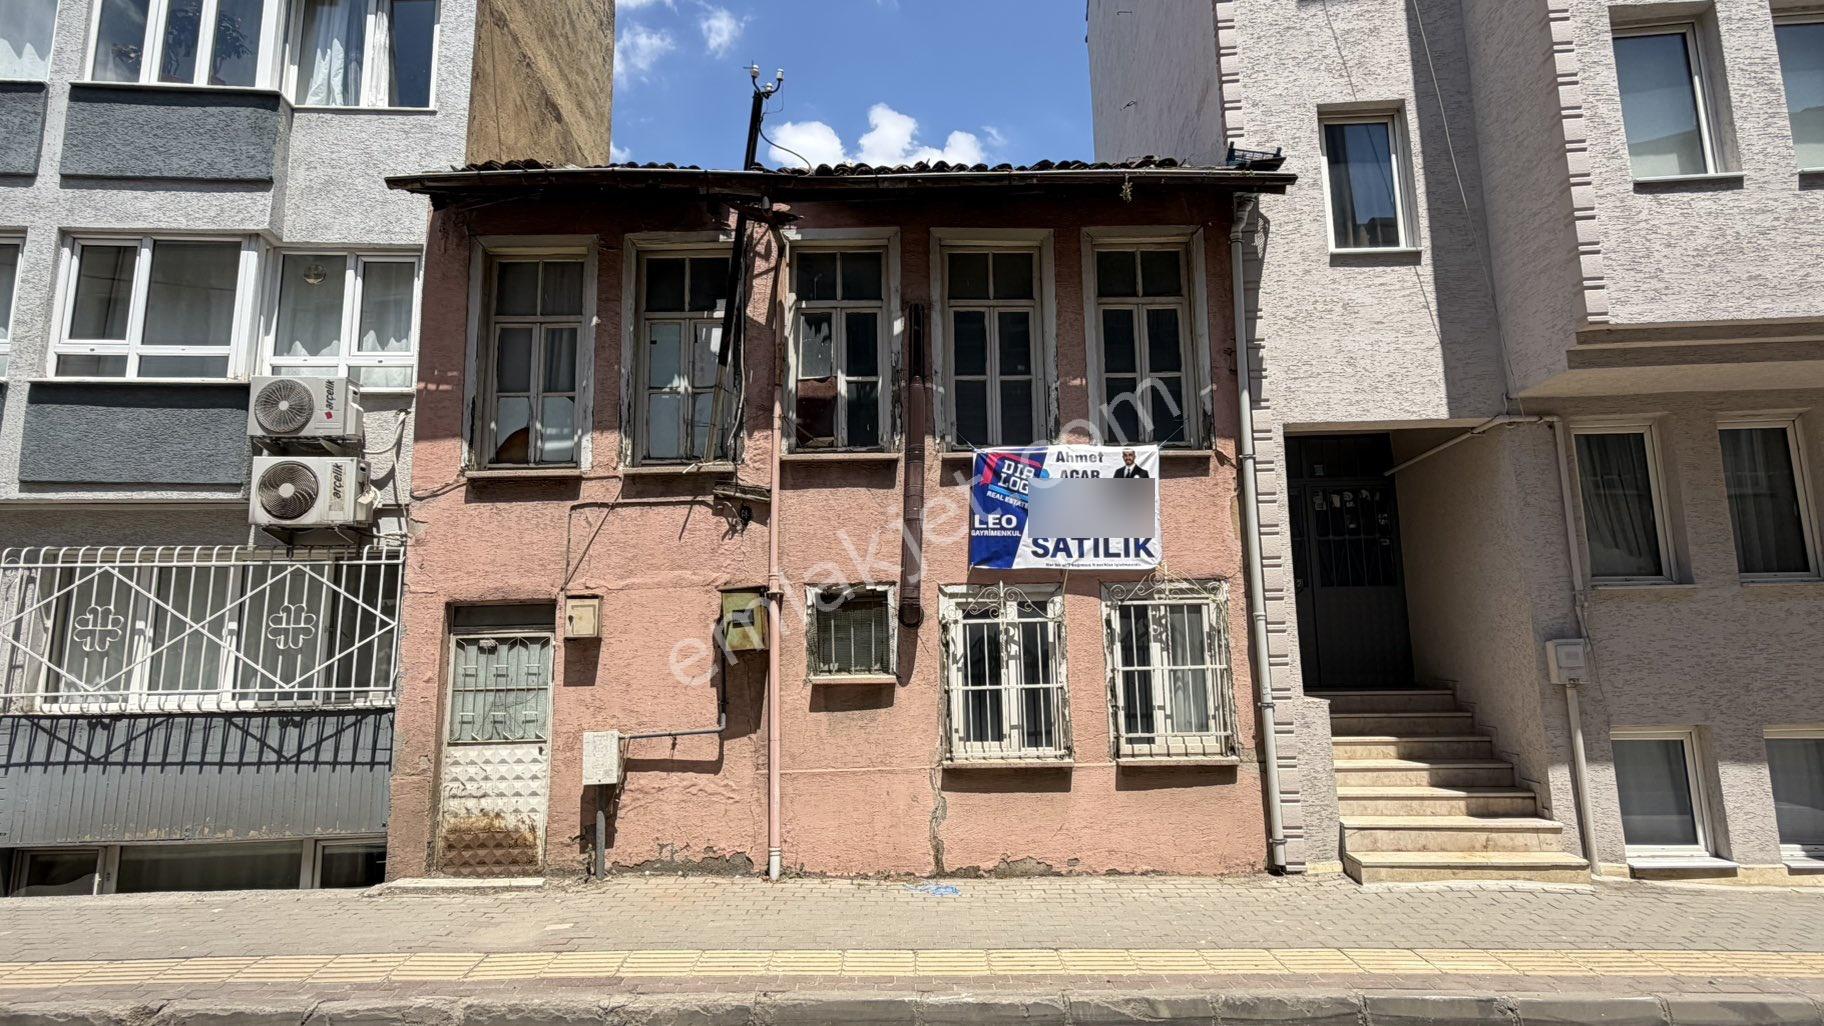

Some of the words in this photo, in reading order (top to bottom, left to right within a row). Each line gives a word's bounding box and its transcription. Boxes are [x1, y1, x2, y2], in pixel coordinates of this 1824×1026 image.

[325, 380, 335, 410] arçelik
[1055, 450, 1104, 463] Ahmet
[332, 463, 344, 499] arçelik
[986, 490, 1004, 501] REAL
[974, 514, 1017, 528] LEO
[1031, 537, 1155, 559] SATILIK
